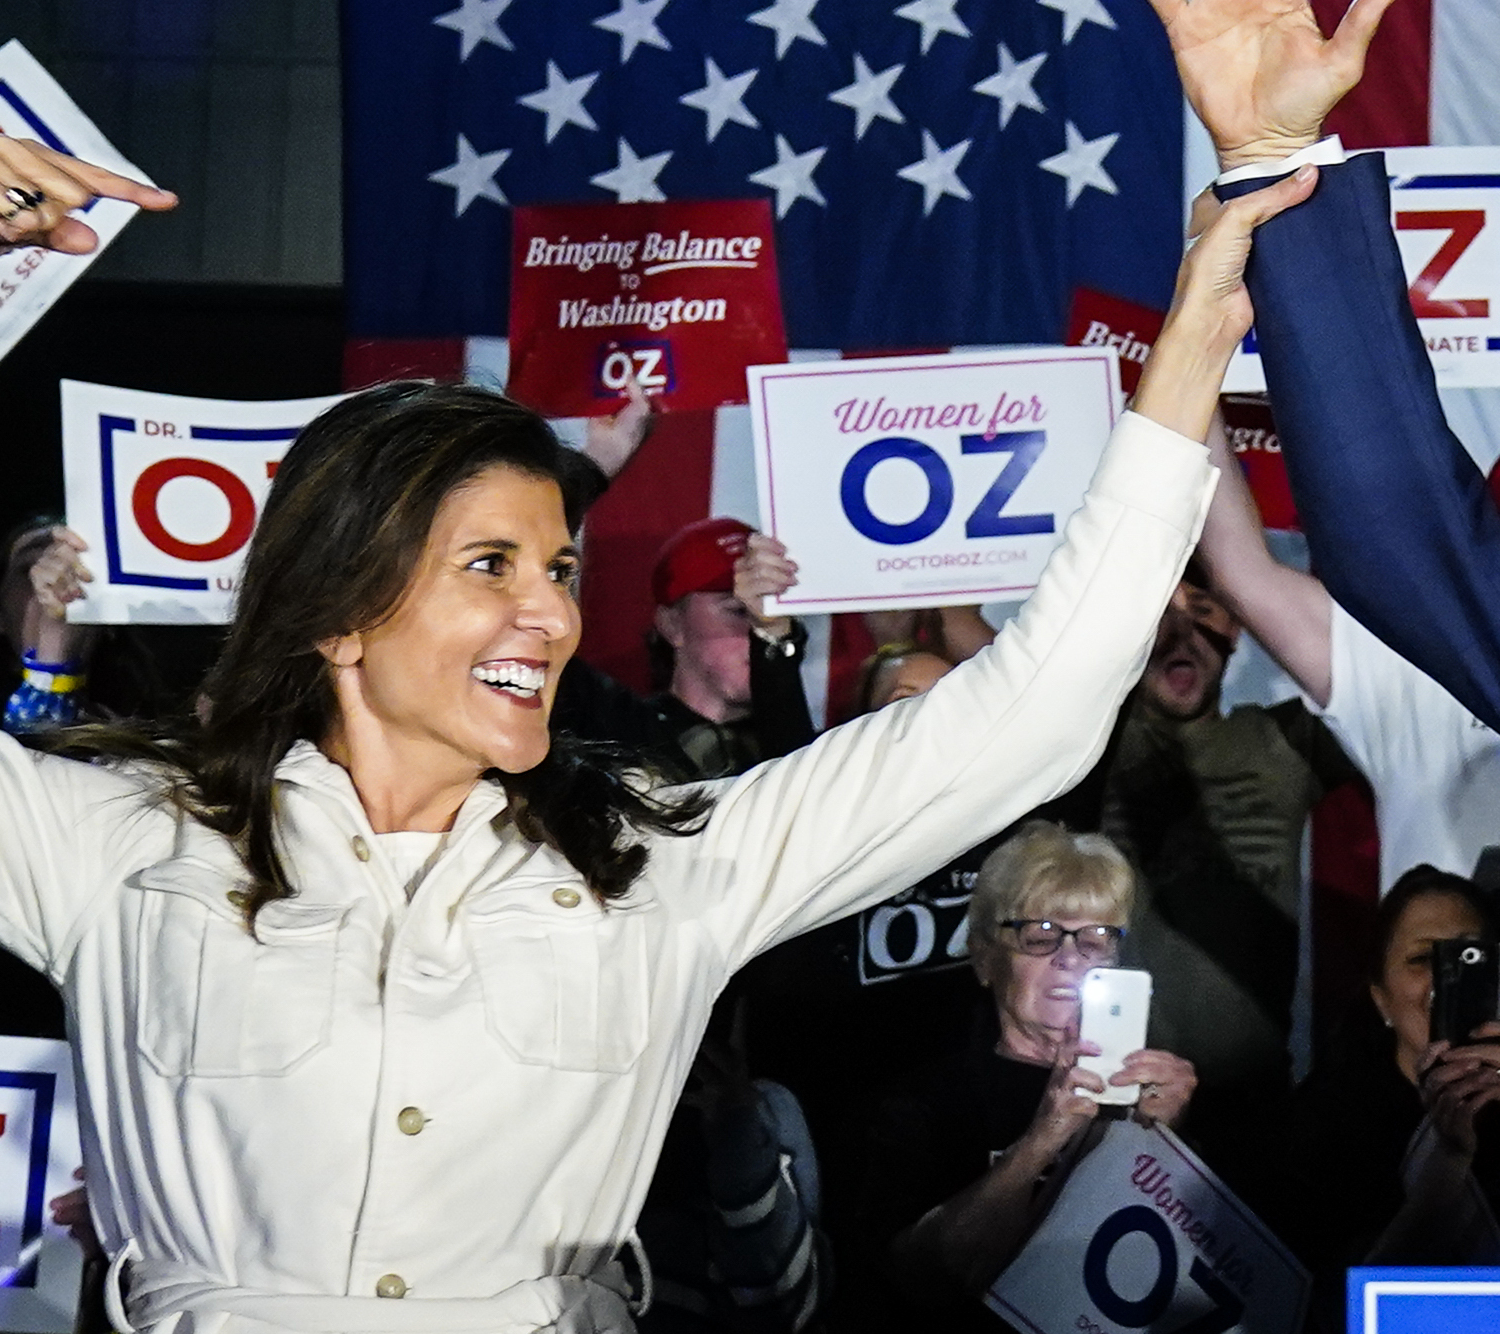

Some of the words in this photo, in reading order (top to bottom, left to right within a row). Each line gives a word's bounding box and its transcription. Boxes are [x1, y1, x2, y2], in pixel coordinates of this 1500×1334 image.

[524, 233, 641, 273] Bringing
[641, 230, 762, 261] Balance
[1396, 210, 1489, 318] Z
[558, 295, 727, 331] Washington
[1080, 319, 1151, 364] Brin
[1425, 336, 1479, 353] NATE
[602, 349, 667, 390] OZ
[143, 419, 184, 440] DR.
[834, 396, 985, 434] Women
[980, 392, 1047, 442] for
[132, 457, 281, 562] O
[840, 430, 1055, 546] OZ
[1131, 1153, 1218, 1256] Women
